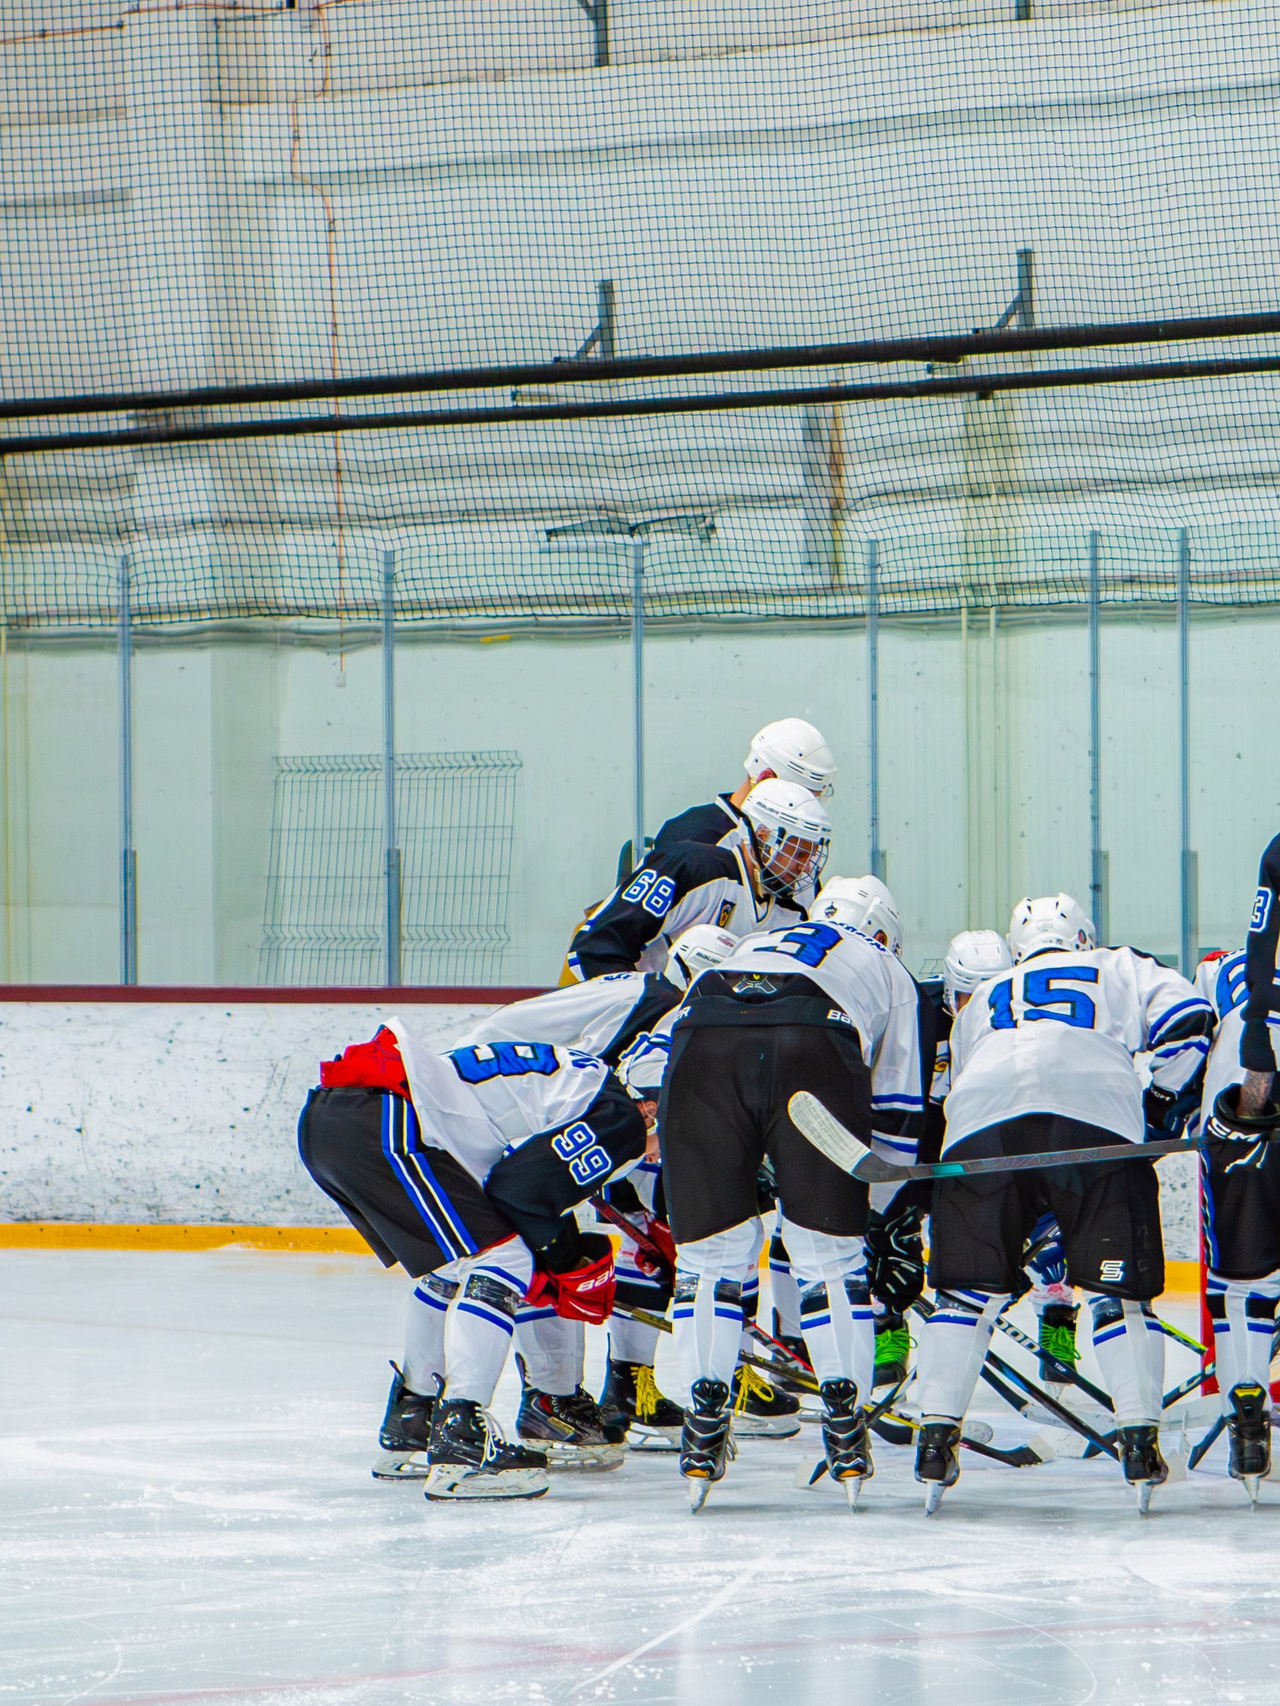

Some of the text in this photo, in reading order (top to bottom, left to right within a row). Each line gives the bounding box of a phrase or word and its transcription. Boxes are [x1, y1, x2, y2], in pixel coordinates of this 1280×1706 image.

[622, 868, 676, 918] 68
[987, 965, 1100, 1030] 15
[551, 1121, 612, 1185] 99
